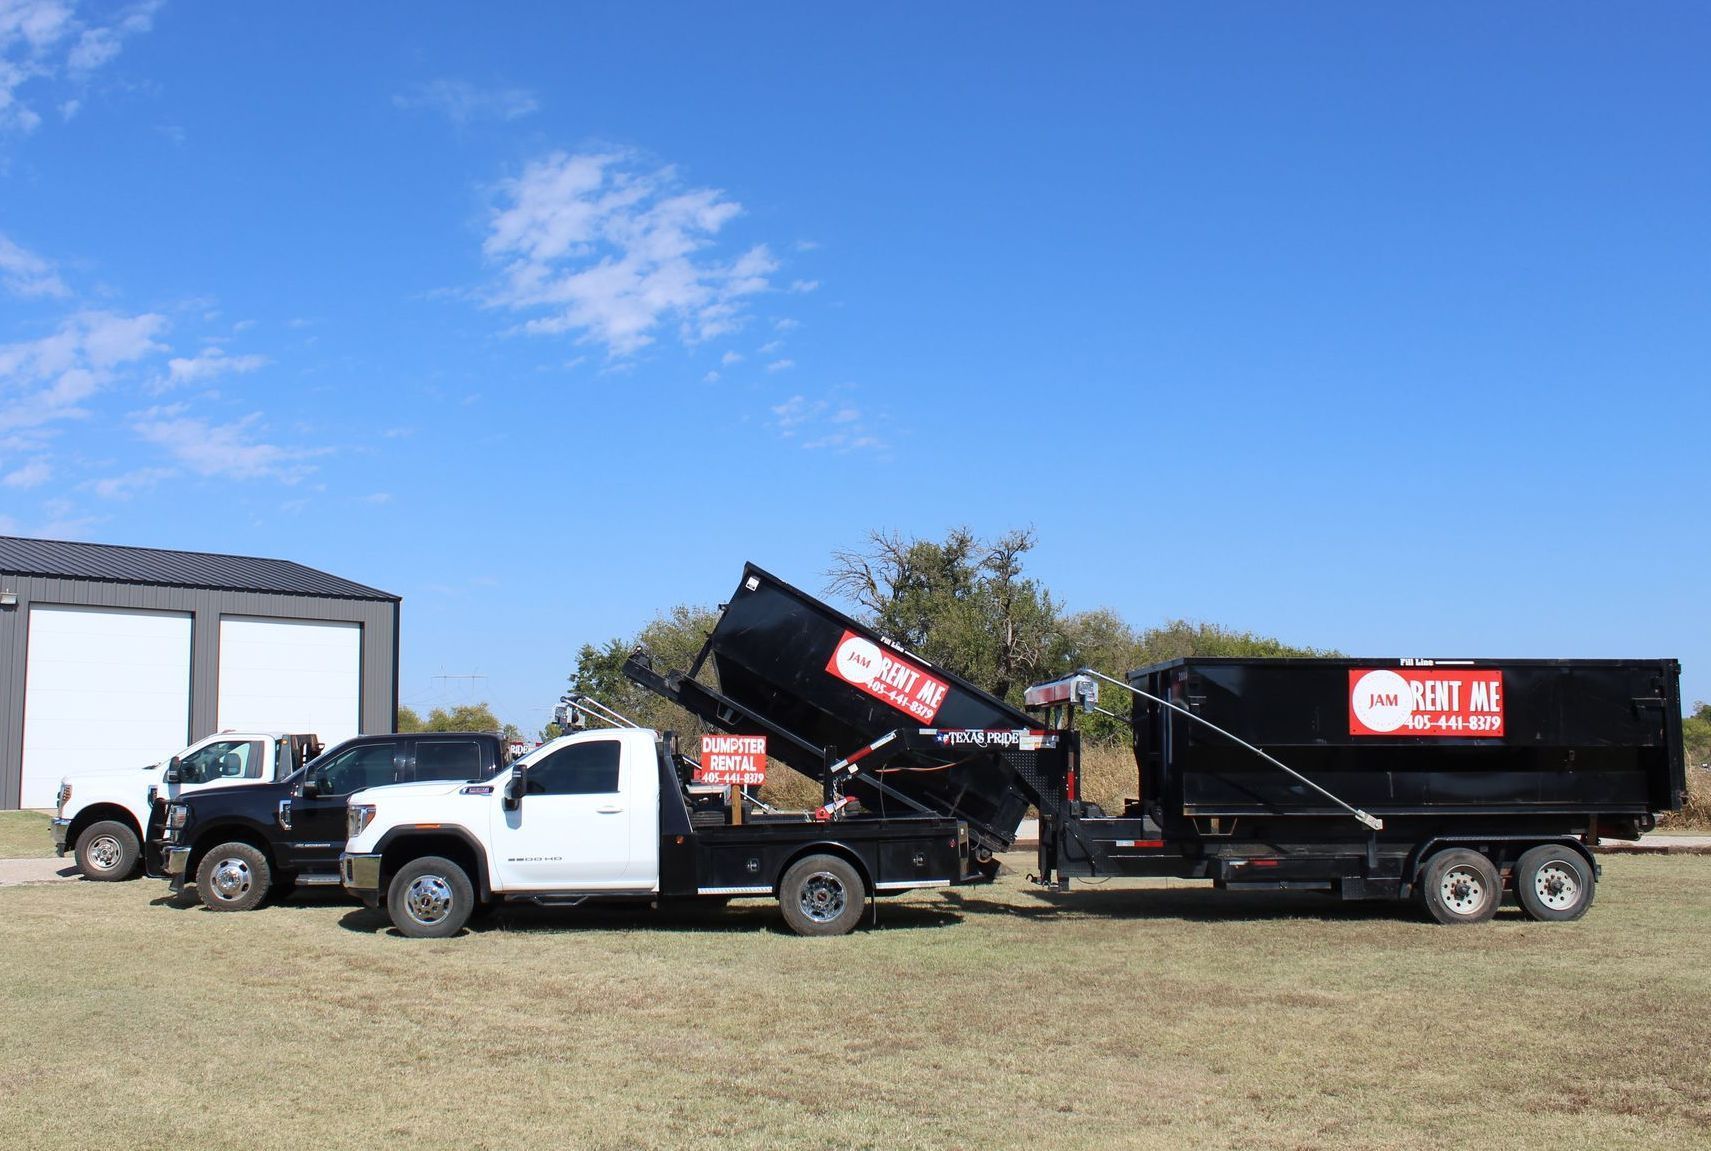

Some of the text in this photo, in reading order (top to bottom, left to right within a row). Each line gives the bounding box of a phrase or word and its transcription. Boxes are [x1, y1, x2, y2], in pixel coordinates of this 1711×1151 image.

[848, 651, 871, 668] JAM
[1400, 658, 1433, 667] Fill Line
[878, 657, 945, 708] RENT ME
[866, 676, 934, 719] 405-441-8379
[1368, 693, 1398, 709] JAM
[1410, 680, 1462, 711] RENT
[1469, 681, 1500, 712] ME
[1404, 715, 1501, 731] 405-441-8379
[702, 737, 766, 754] DUMPSTER
[949, 731, 1019, 748] TEXAS PRIDE
[510, 744, 529, 756] RIDE
[710, 755, 757, 771] RENTAL
[702, 772, 765, 784] 405-441-8379
